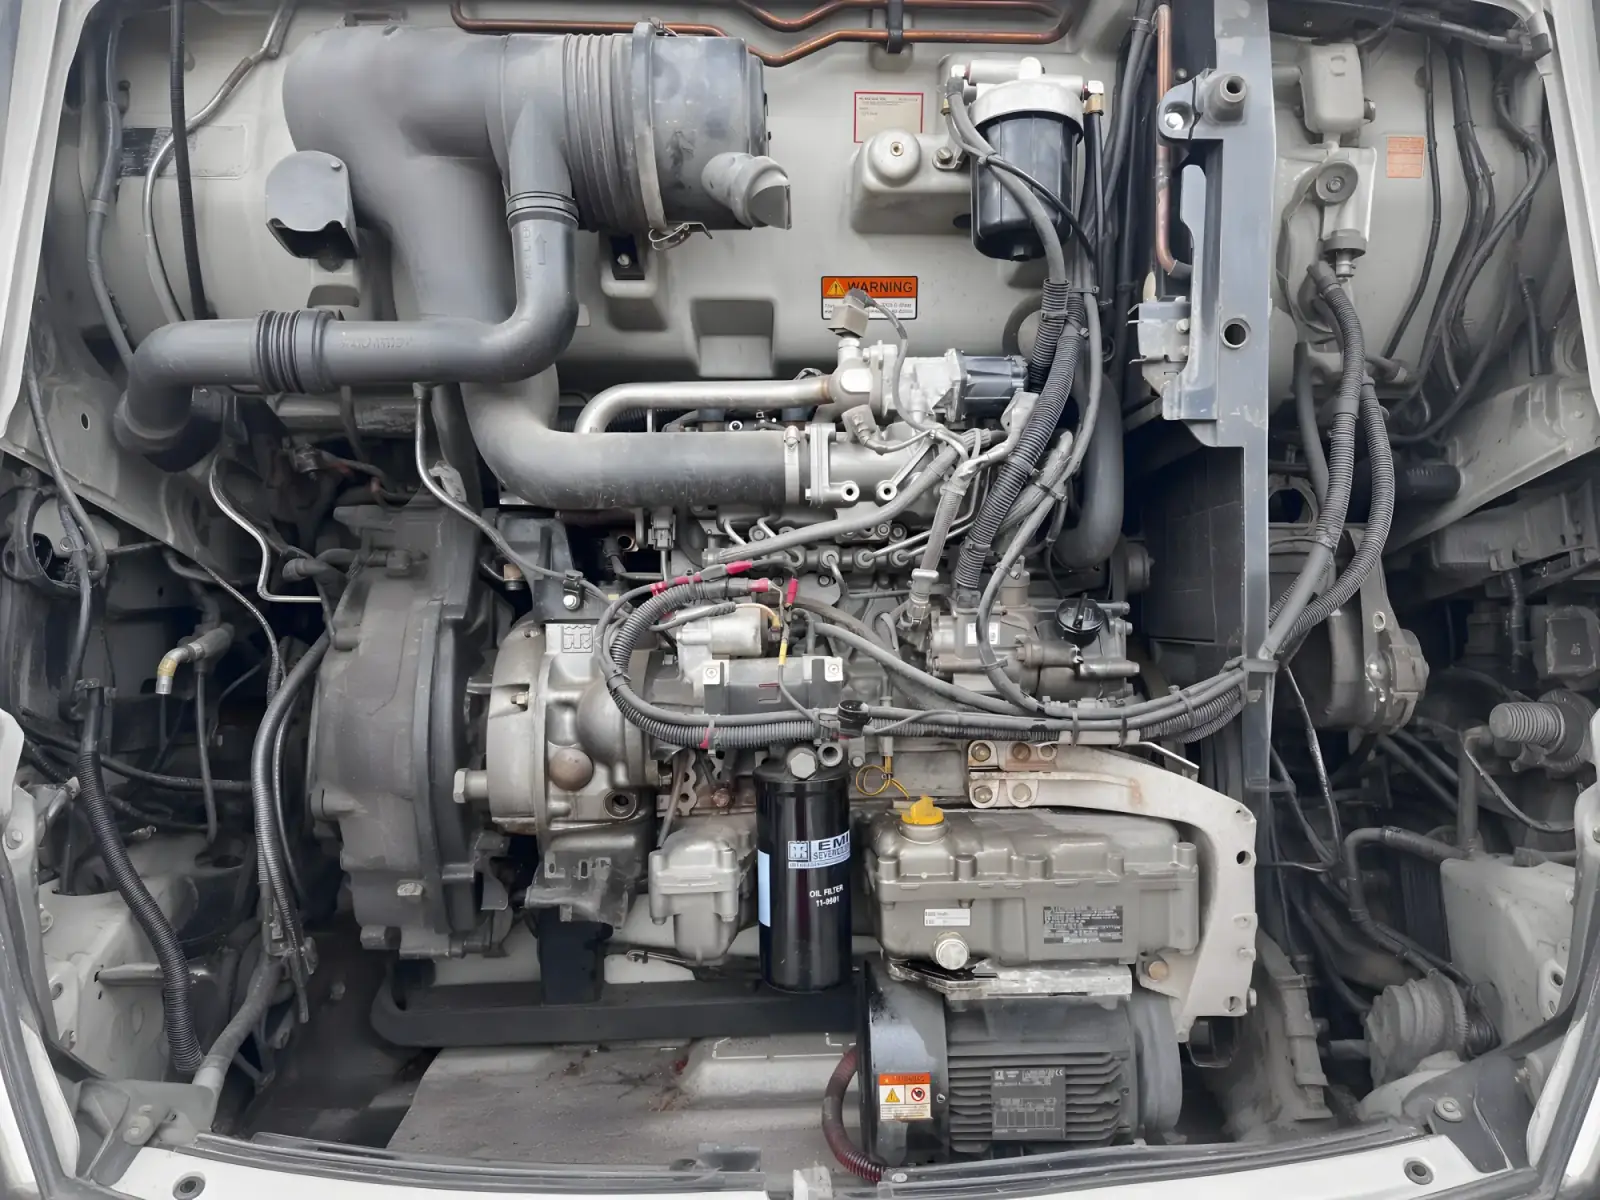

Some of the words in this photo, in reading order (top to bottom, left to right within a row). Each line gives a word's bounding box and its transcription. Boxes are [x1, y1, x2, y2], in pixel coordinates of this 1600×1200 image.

[847, 281, 913, 293] WARNING
[809, 890, 822, 898] OIL
[823, 884, 844, 896] FILTER
